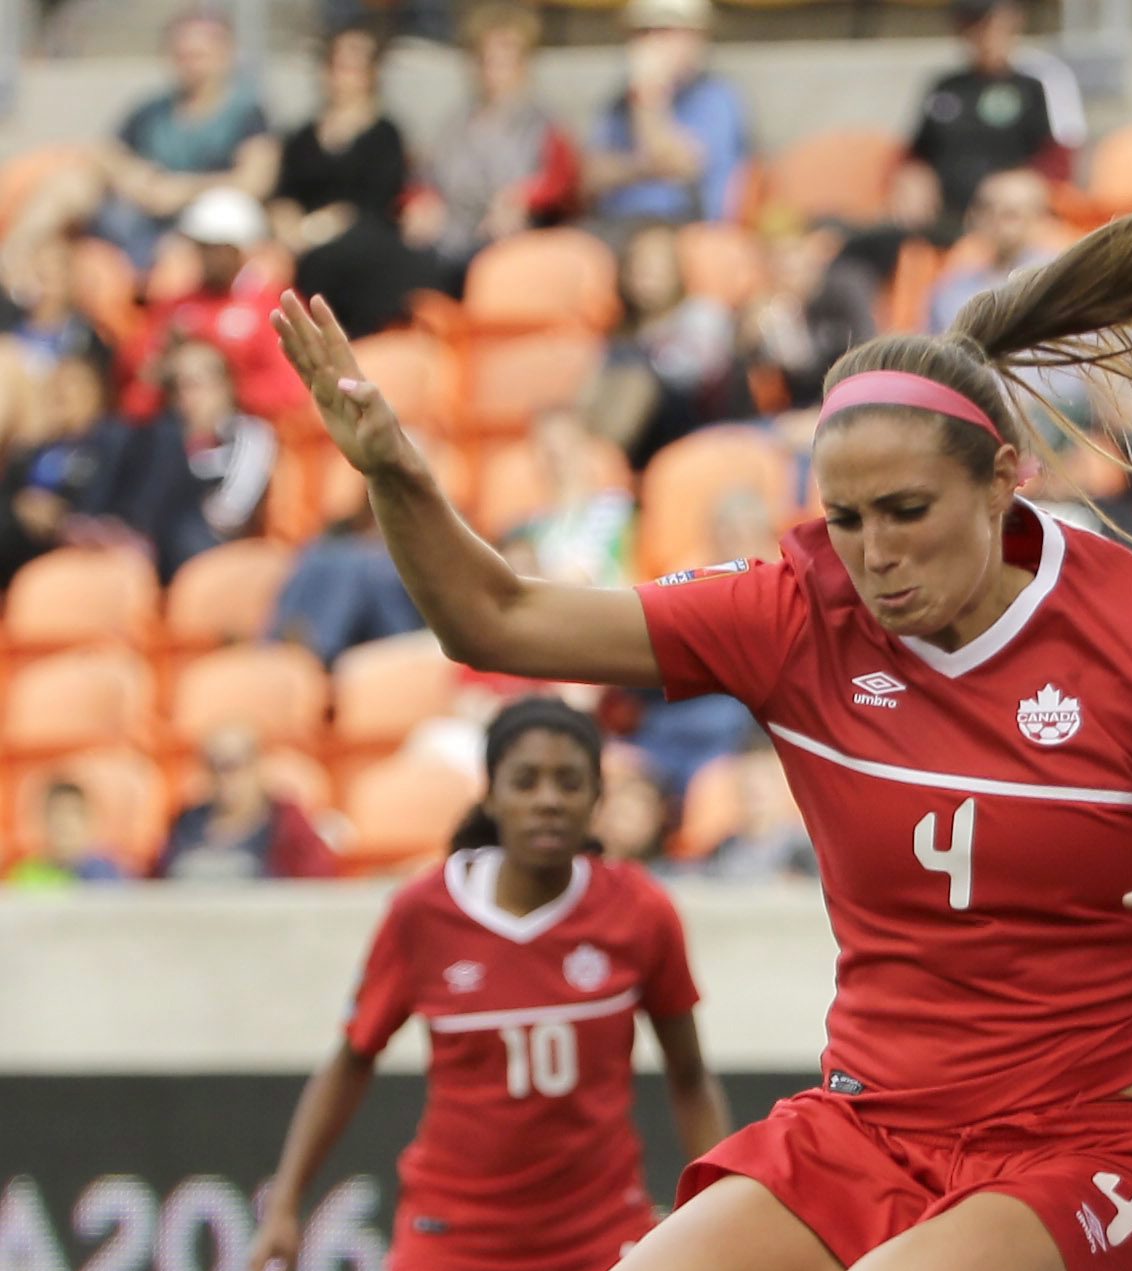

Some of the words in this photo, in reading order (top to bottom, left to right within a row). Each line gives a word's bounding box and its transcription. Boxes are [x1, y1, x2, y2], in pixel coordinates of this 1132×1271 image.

[853, 693, 897, 708] umbro
[1017, 711, 1079, 723] CANADA
[913, 797, 975, 910] 4
[499, 1022, 579, 1098] 10
